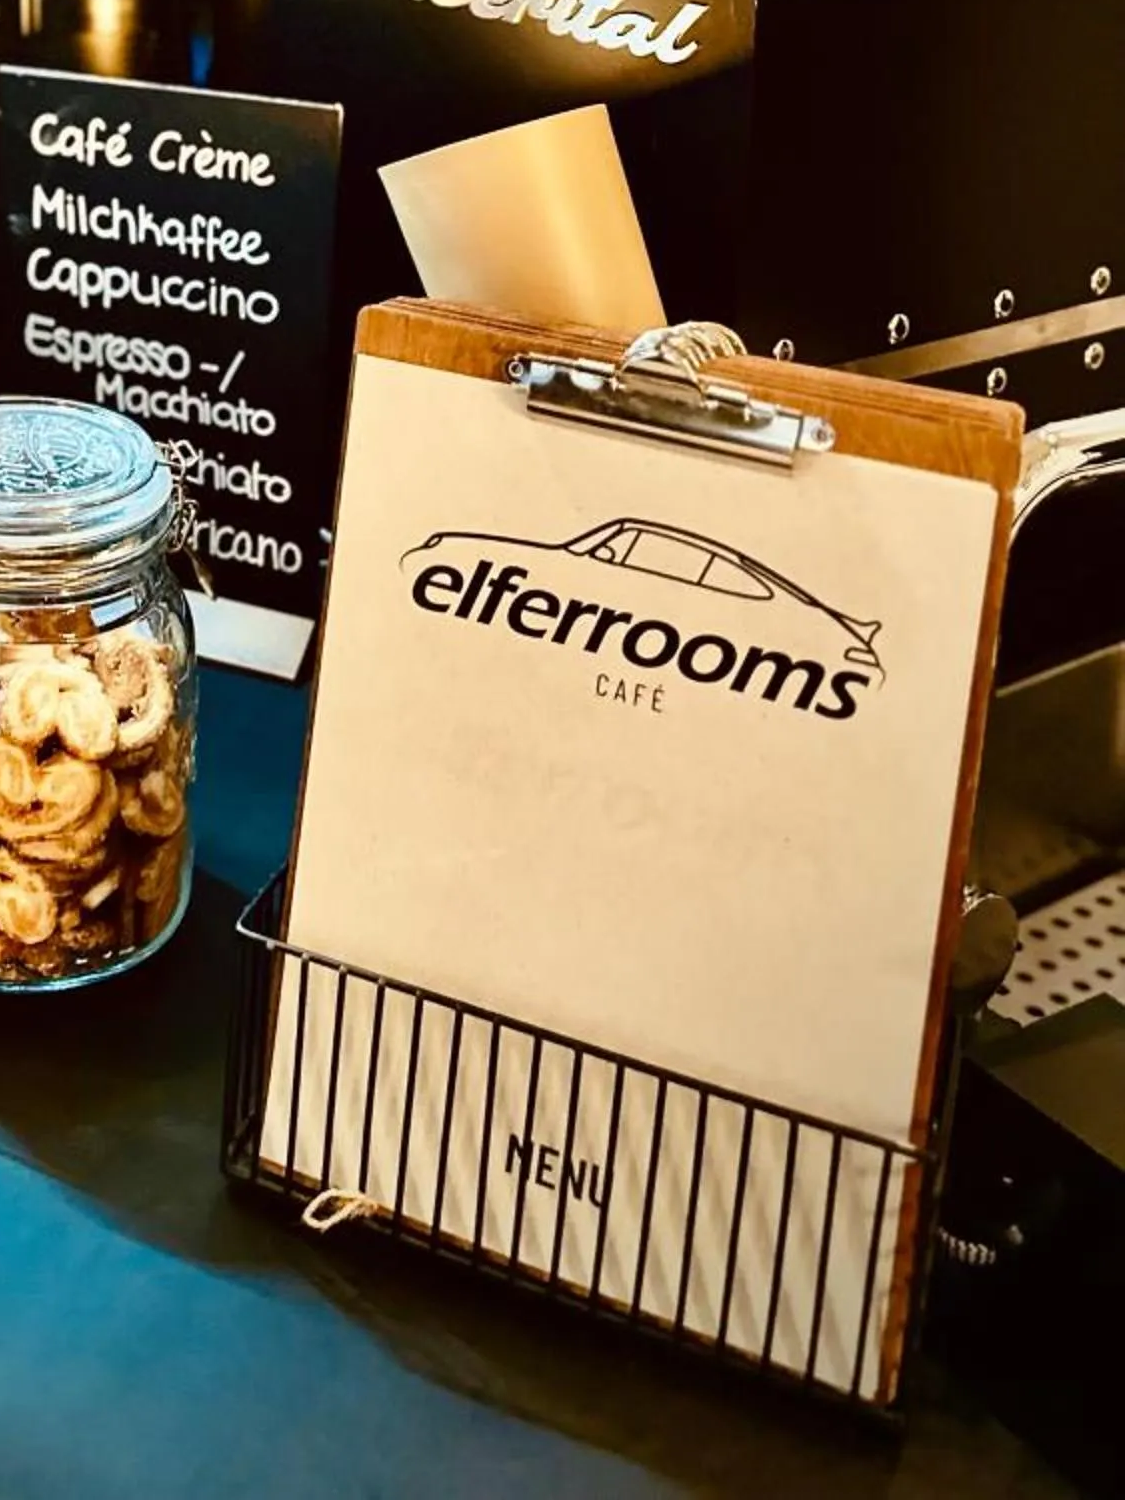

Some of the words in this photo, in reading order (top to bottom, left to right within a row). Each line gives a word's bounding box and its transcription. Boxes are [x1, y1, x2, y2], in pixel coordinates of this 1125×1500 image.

[29, 112, 133, 168] Café
[148, 129, 276, 187] Crème
[31, 184, 270, 266] Milchkaffee
[26, 247, 280, 325] Cappuccino
[95, 372, 276, 437] Macchiato
[411, 560, 871, 720] elferrooms
[595, 673, 665, 714] CAFÉ
